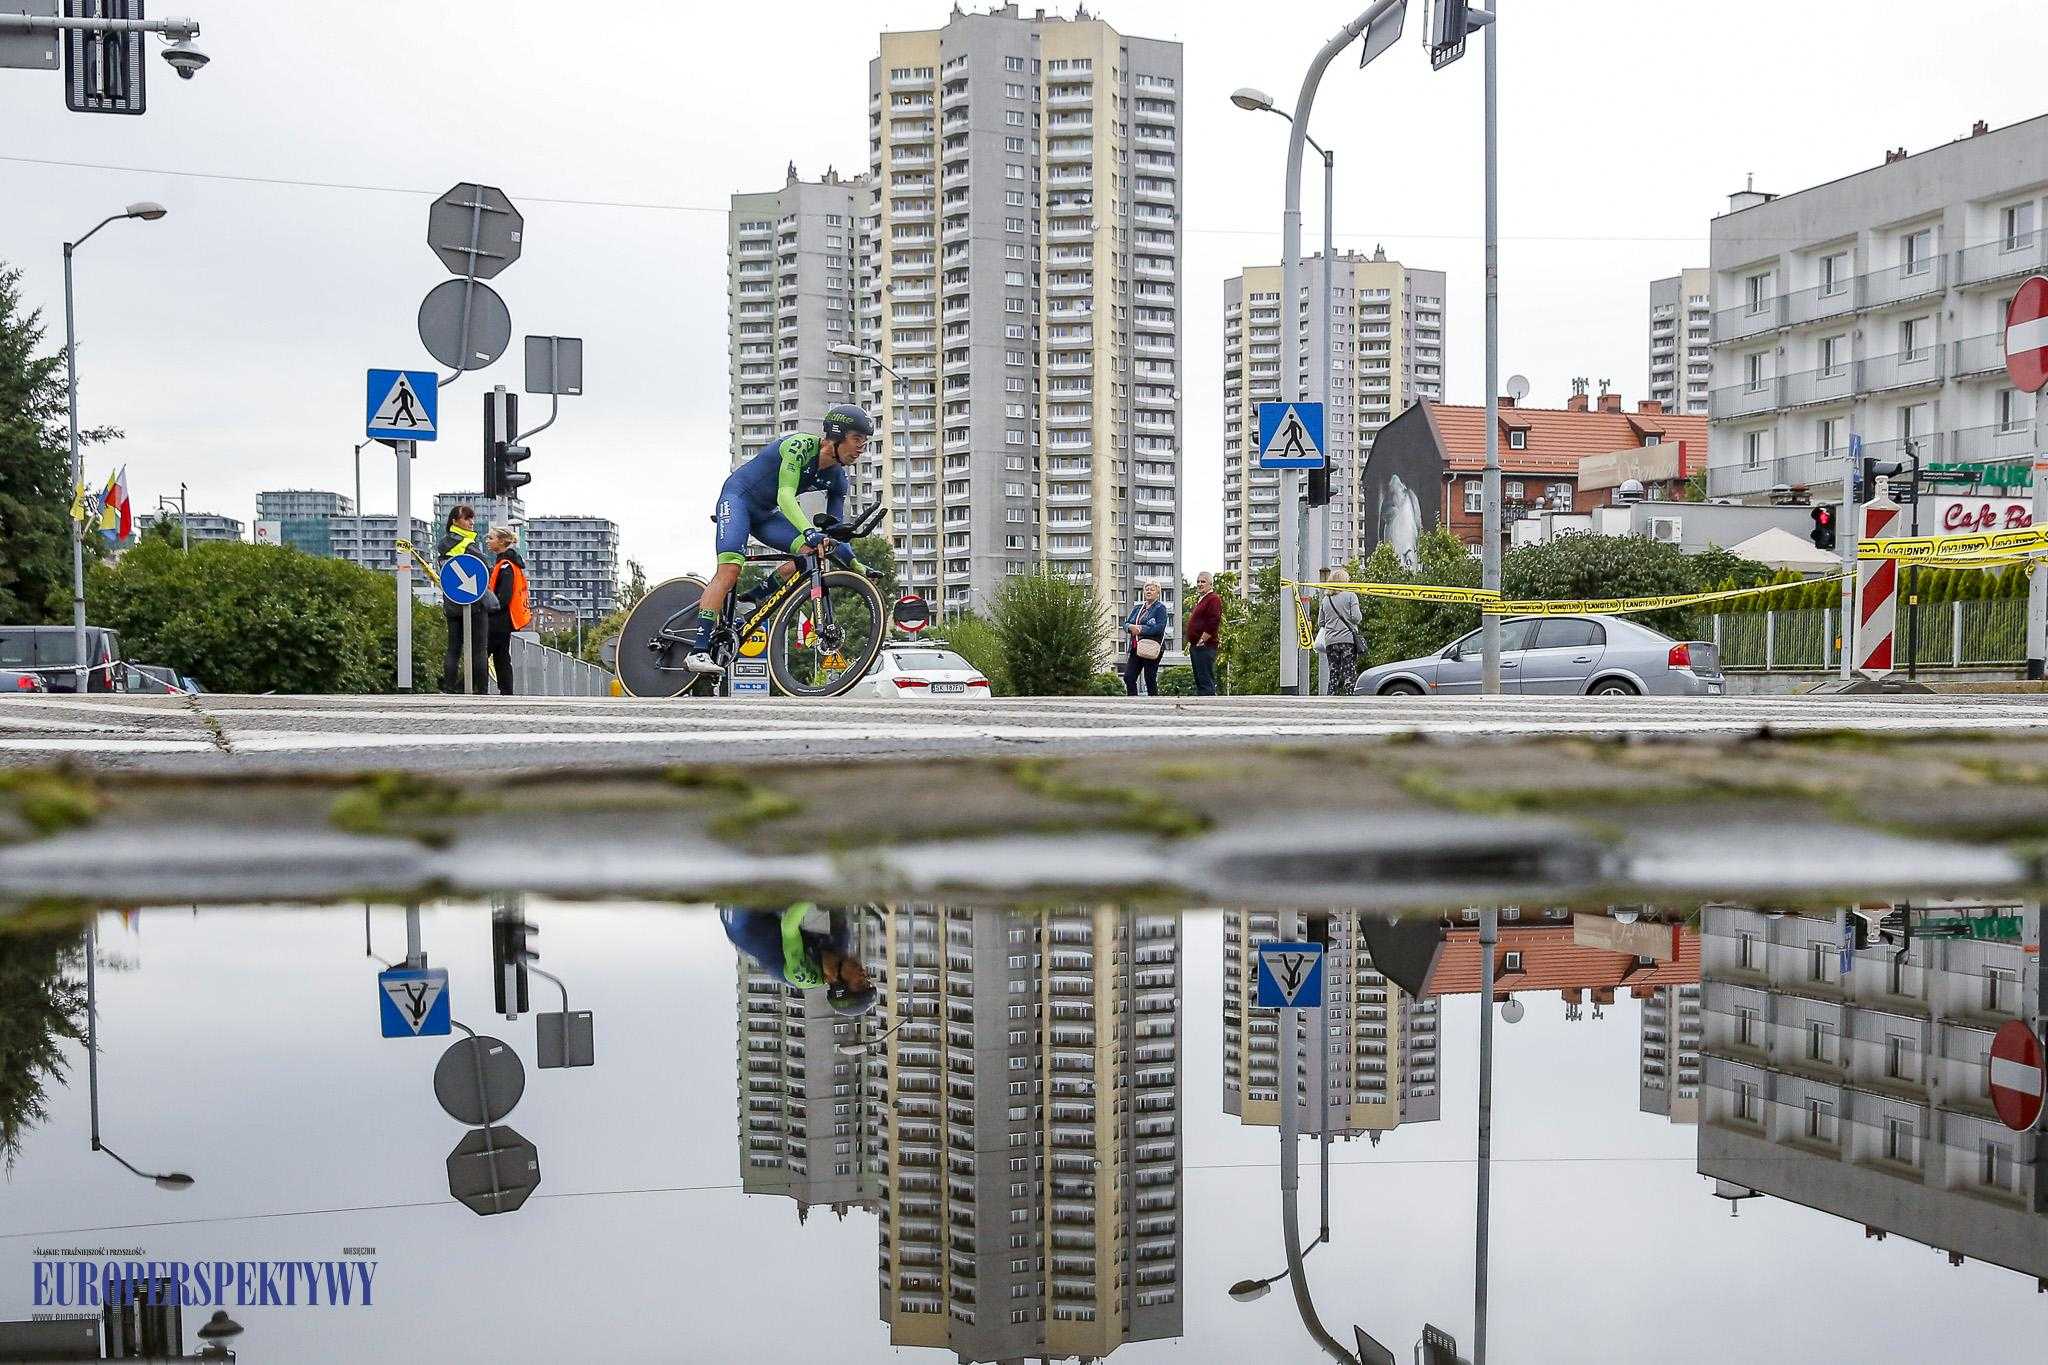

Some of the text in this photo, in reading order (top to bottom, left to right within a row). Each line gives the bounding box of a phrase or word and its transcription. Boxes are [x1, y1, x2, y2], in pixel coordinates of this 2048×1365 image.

[1944, 503, 1997, 532] Cafe
[1887, 545, 1931, 556] LANGTEAM
[742, 585, 788, 637] ARGON
